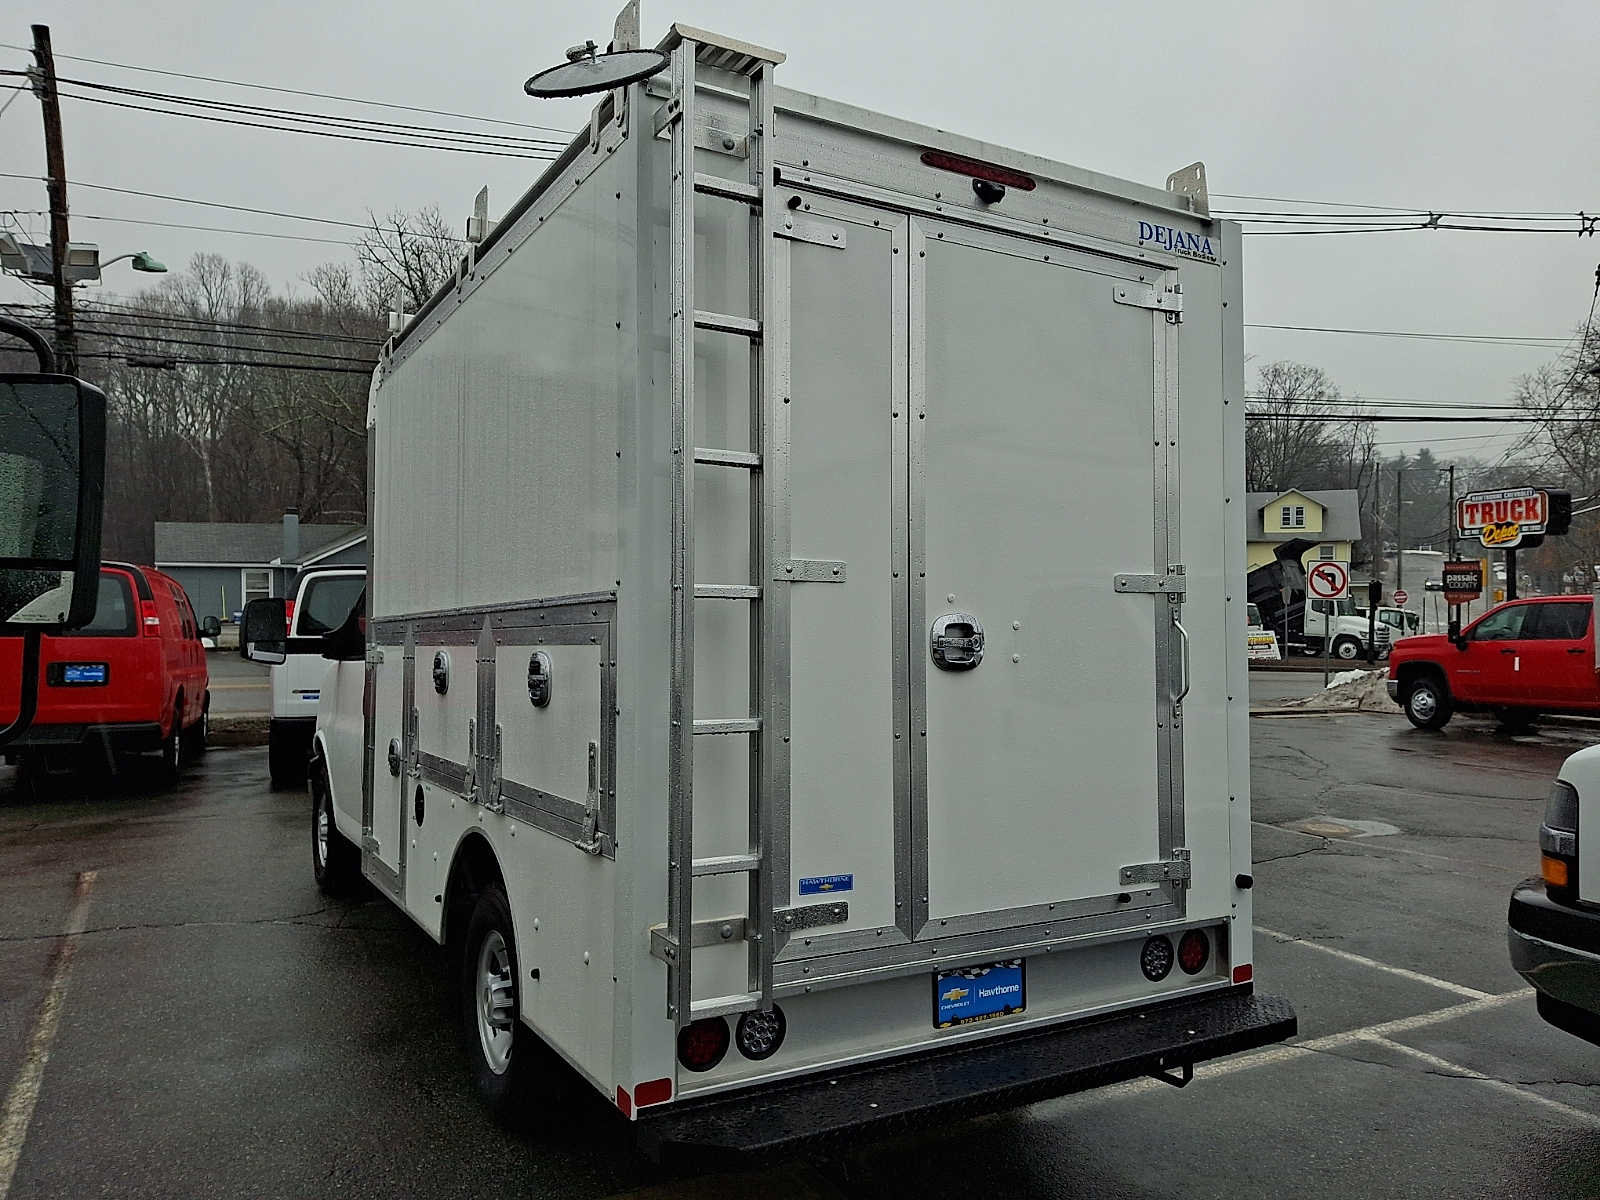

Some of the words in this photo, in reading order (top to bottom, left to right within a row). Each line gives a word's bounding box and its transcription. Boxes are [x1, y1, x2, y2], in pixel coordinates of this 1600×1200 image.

[1138, 221, 1214, 255] DEJANA
[1174, 247, 1192, 256] Truck
[1465, 497, 1540, 525] TRUCK
[1447, 572, 1478, 584] passaic
[1449, 581, 1478, 589] COUNTY
[801, 875, 849, 885] HAWTHORNE
[978, 984, 1020, 998] Hawthorne
[940, 1001, 970, 1010] CHEVROLET
